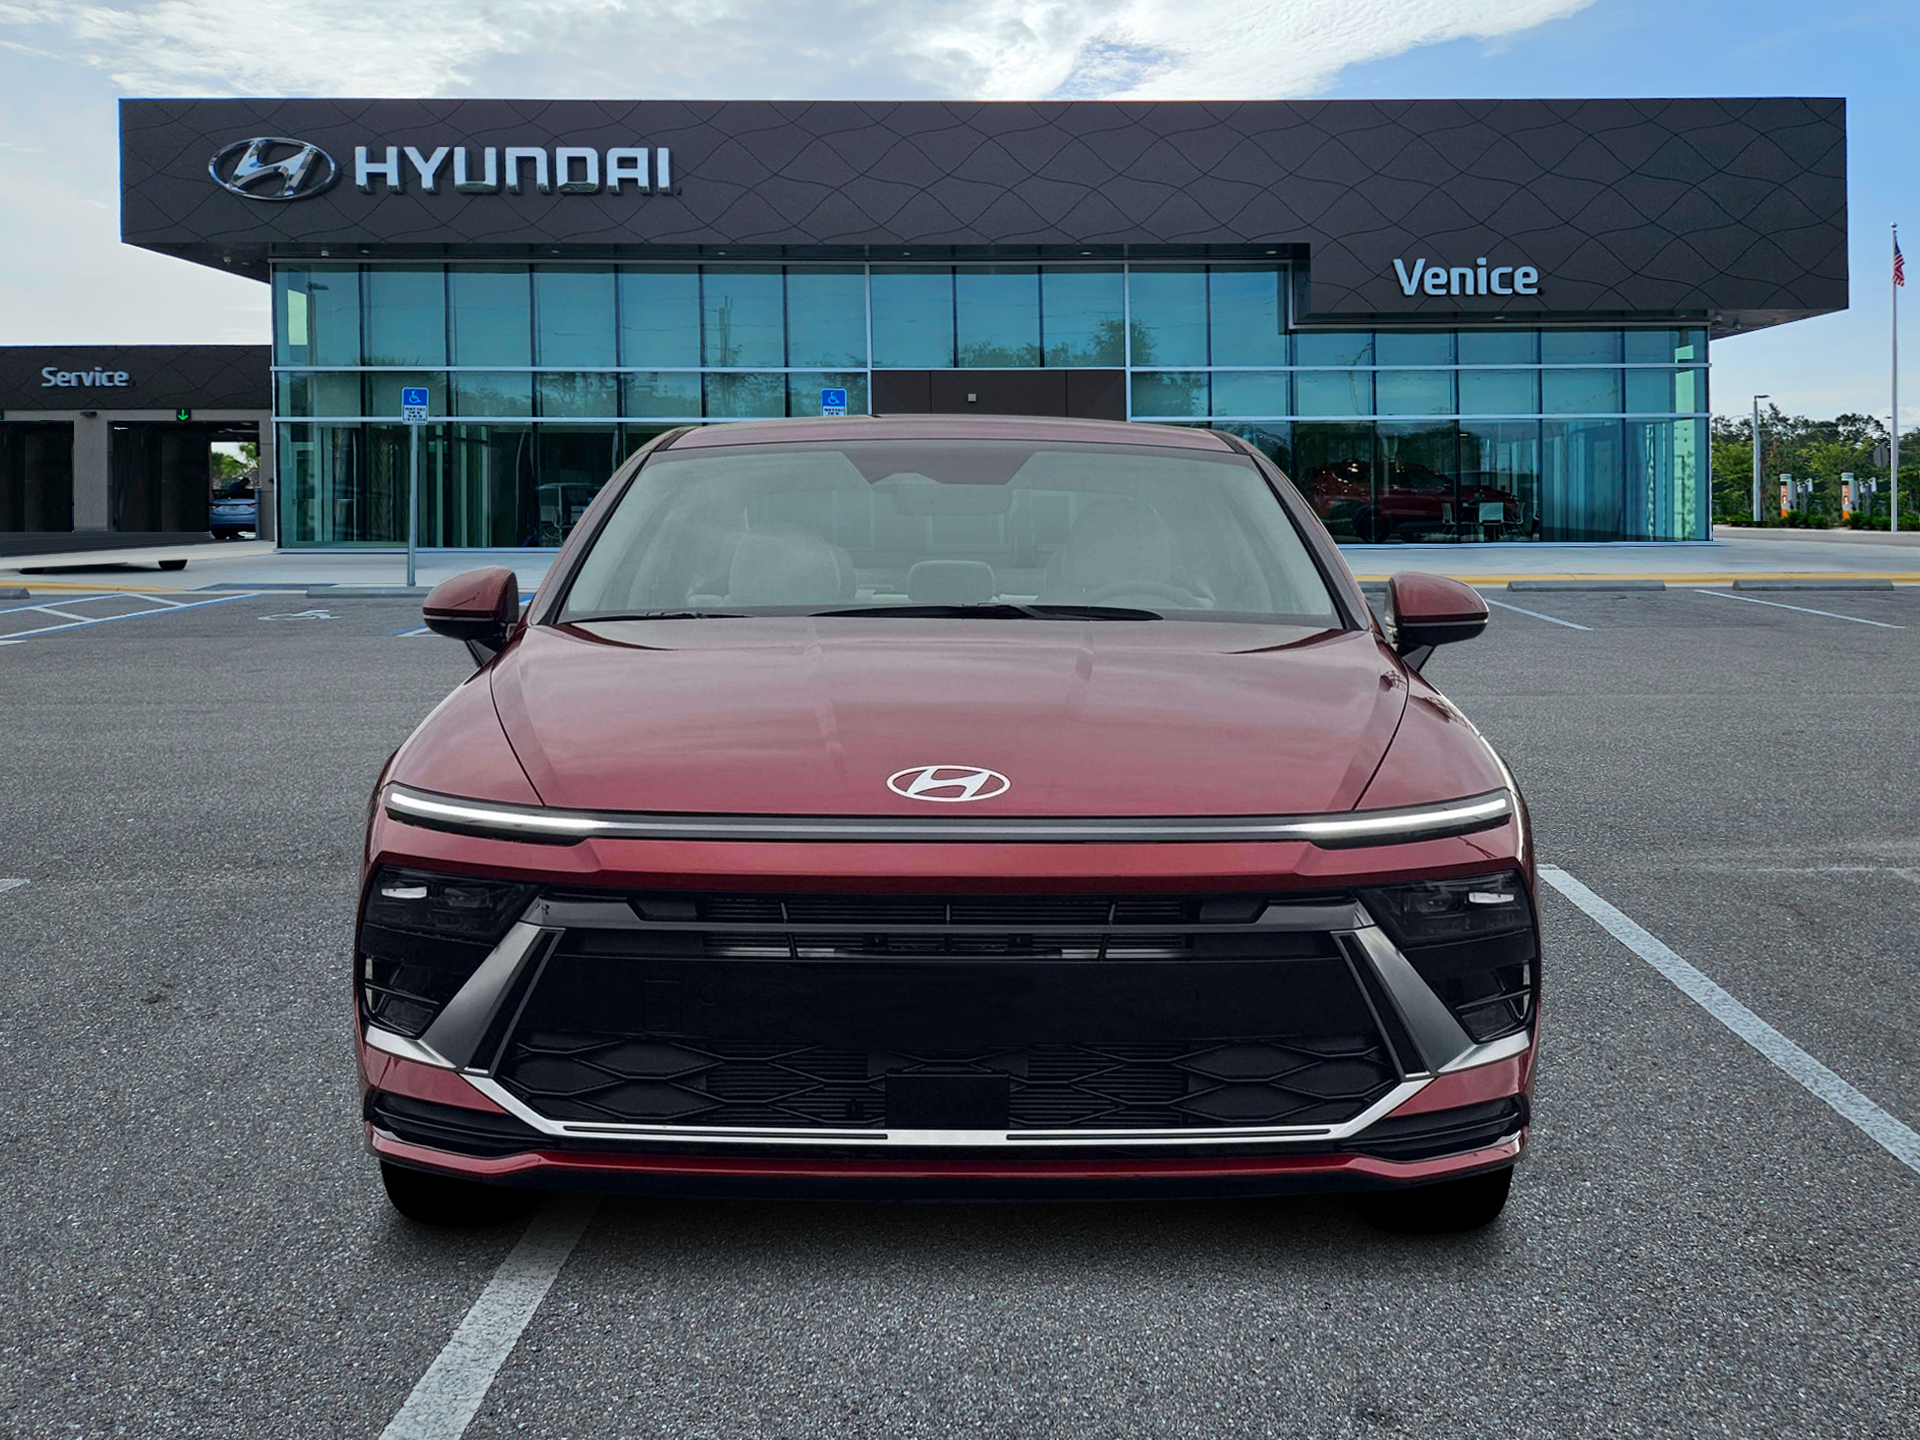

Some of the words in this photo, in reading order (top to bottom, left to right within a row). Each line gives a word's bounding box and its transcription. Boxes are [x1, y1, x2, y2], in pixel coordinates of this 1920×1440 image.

[353, 145, 671, 195] HYUNDAI
[1393, 257, 1540, 297] Venice
[41, 366, 130, 388] Service
